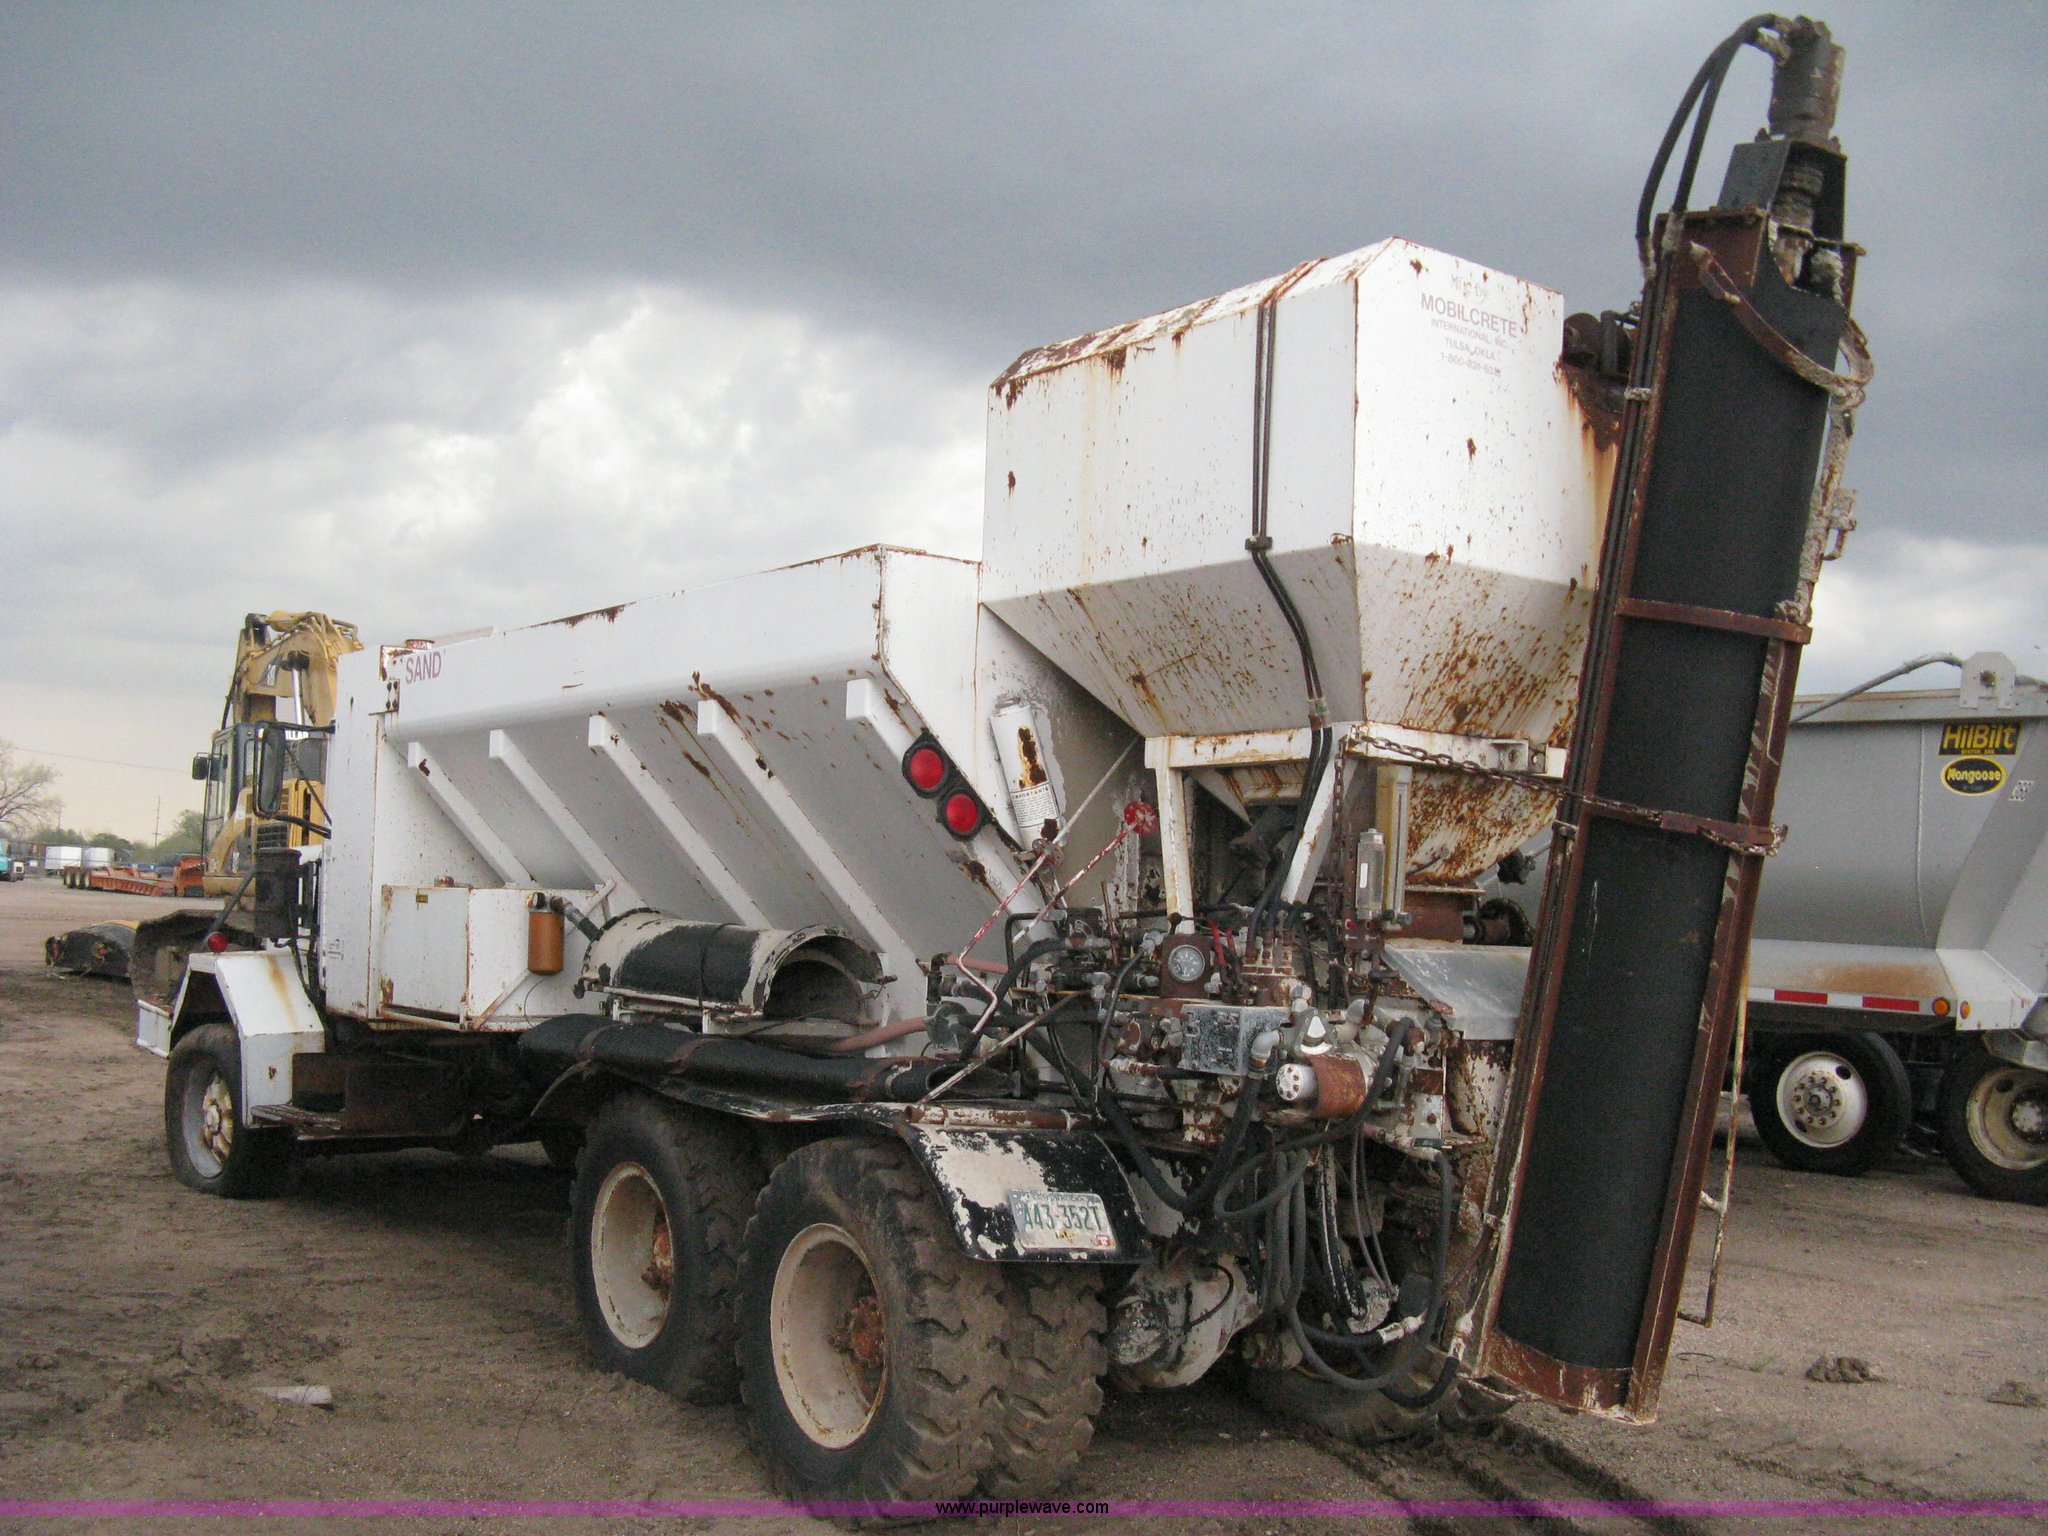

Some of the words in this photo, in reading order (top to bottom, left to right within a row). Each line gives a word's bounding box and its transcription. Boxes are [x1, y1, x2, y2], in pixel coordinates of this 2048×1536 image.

[1421, 293, 1517, 338] MOBILCRETE
[405, 651, 442, 684] SAND
[1942, 723, 2016, 749] HilBilt
[1946, 767, 2003, 784] Mongoose
